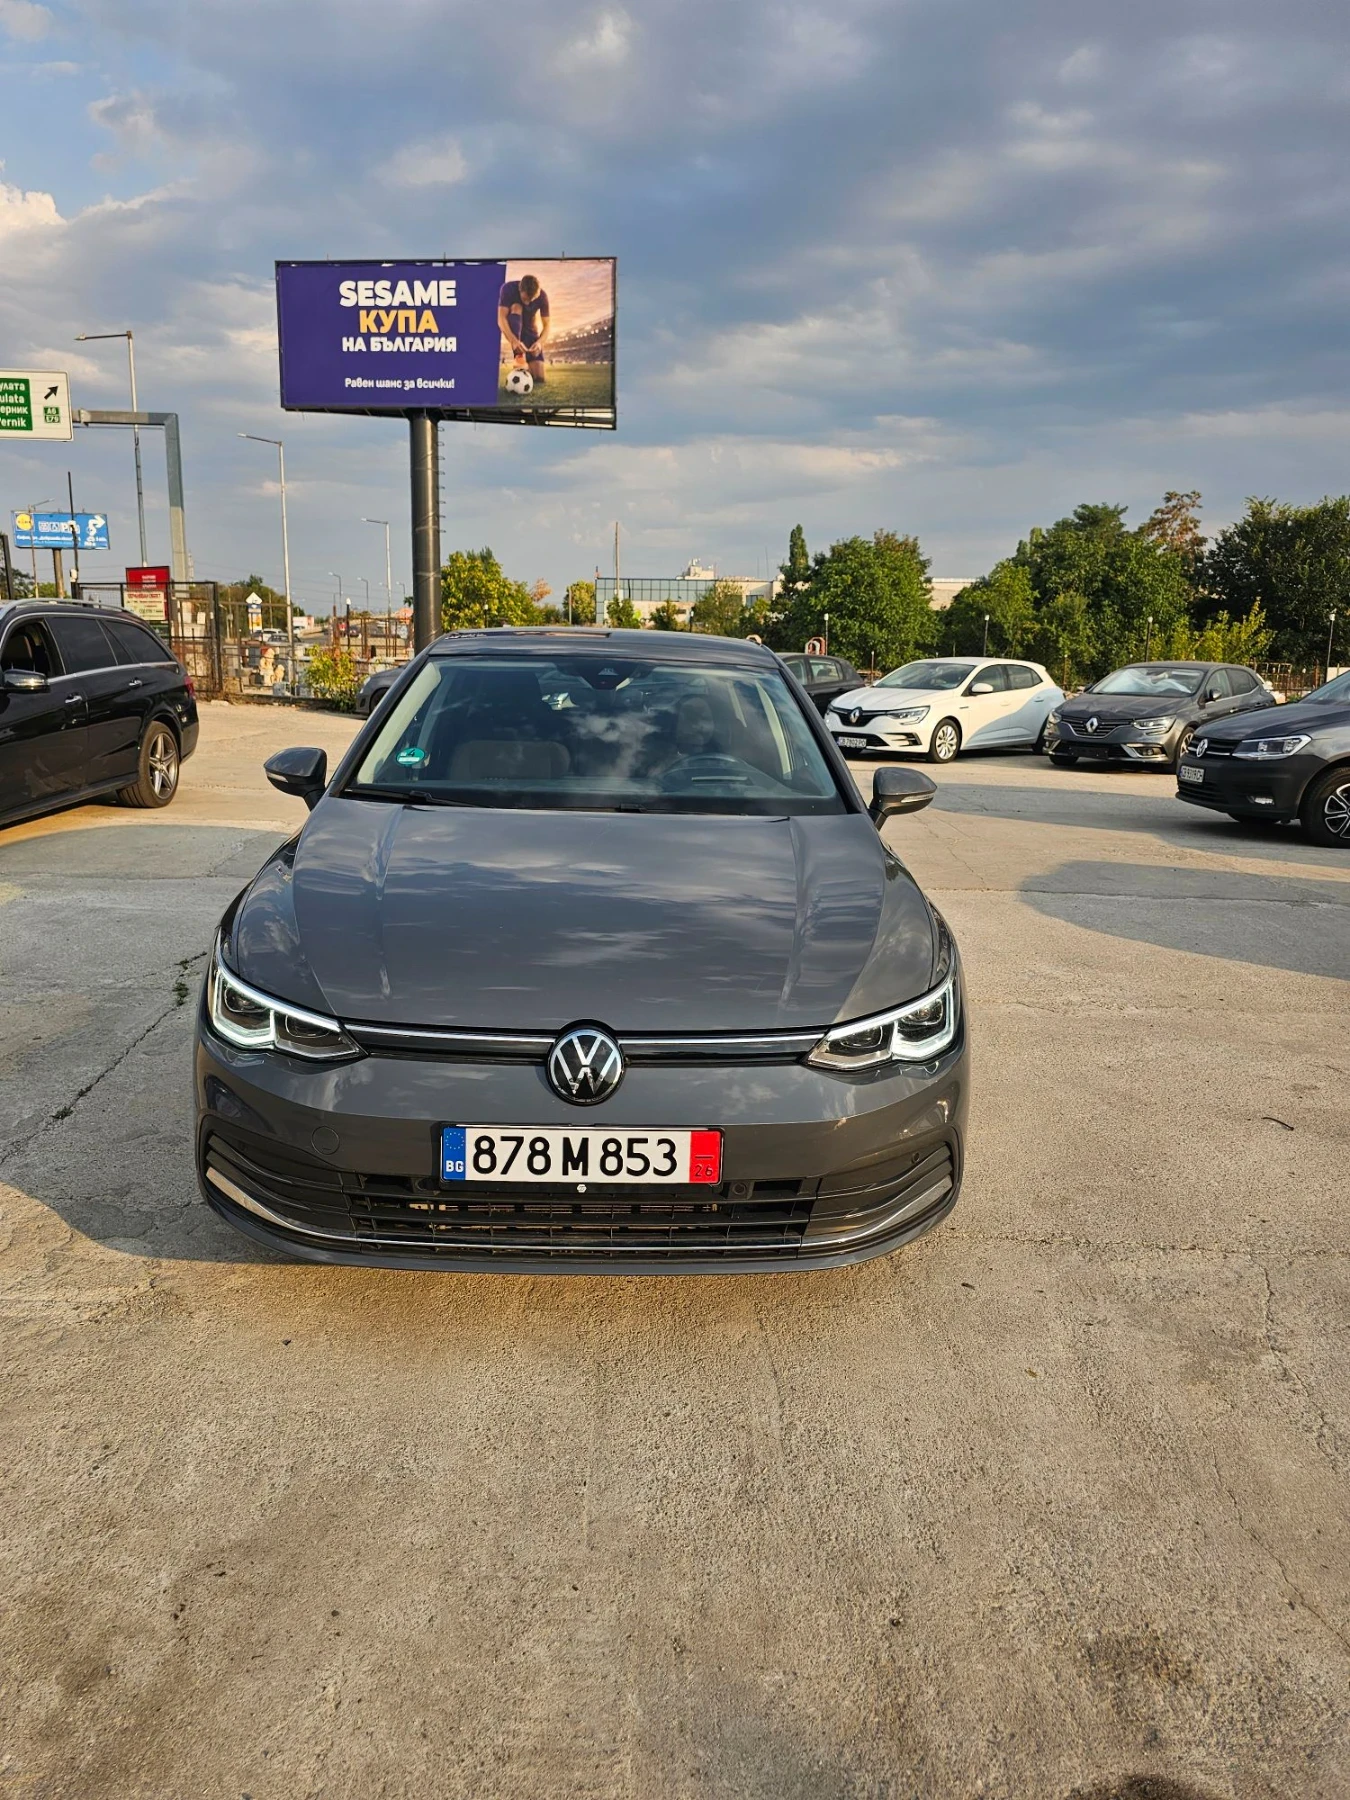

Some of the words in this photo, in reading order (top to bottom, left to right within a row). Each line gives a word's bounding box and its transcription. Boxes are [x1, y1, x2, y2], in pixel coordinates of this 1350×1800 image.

[339, 280, 457, 307] SESAME
[359, 309, 439, 334] КУПА
[342, 336, 367, 352] НА
[370, 336, 457, 353] БЪЛГАРИЯ
[344, 377, 375, 388] Равен
[376, 379, 402, 389] шанс
[403, 379, 416, 391] за
[416, 377, 455, 389] всички!
[0, 416, 26, 427] ernik
[473, 1135, 551, 1175] 878
[562, 1137, 589, 1176] M
[599, 1137, 678, 1176] 853
[445, 1160, 464, 1172] BG
[694, 1164, 713, 1177] 26
